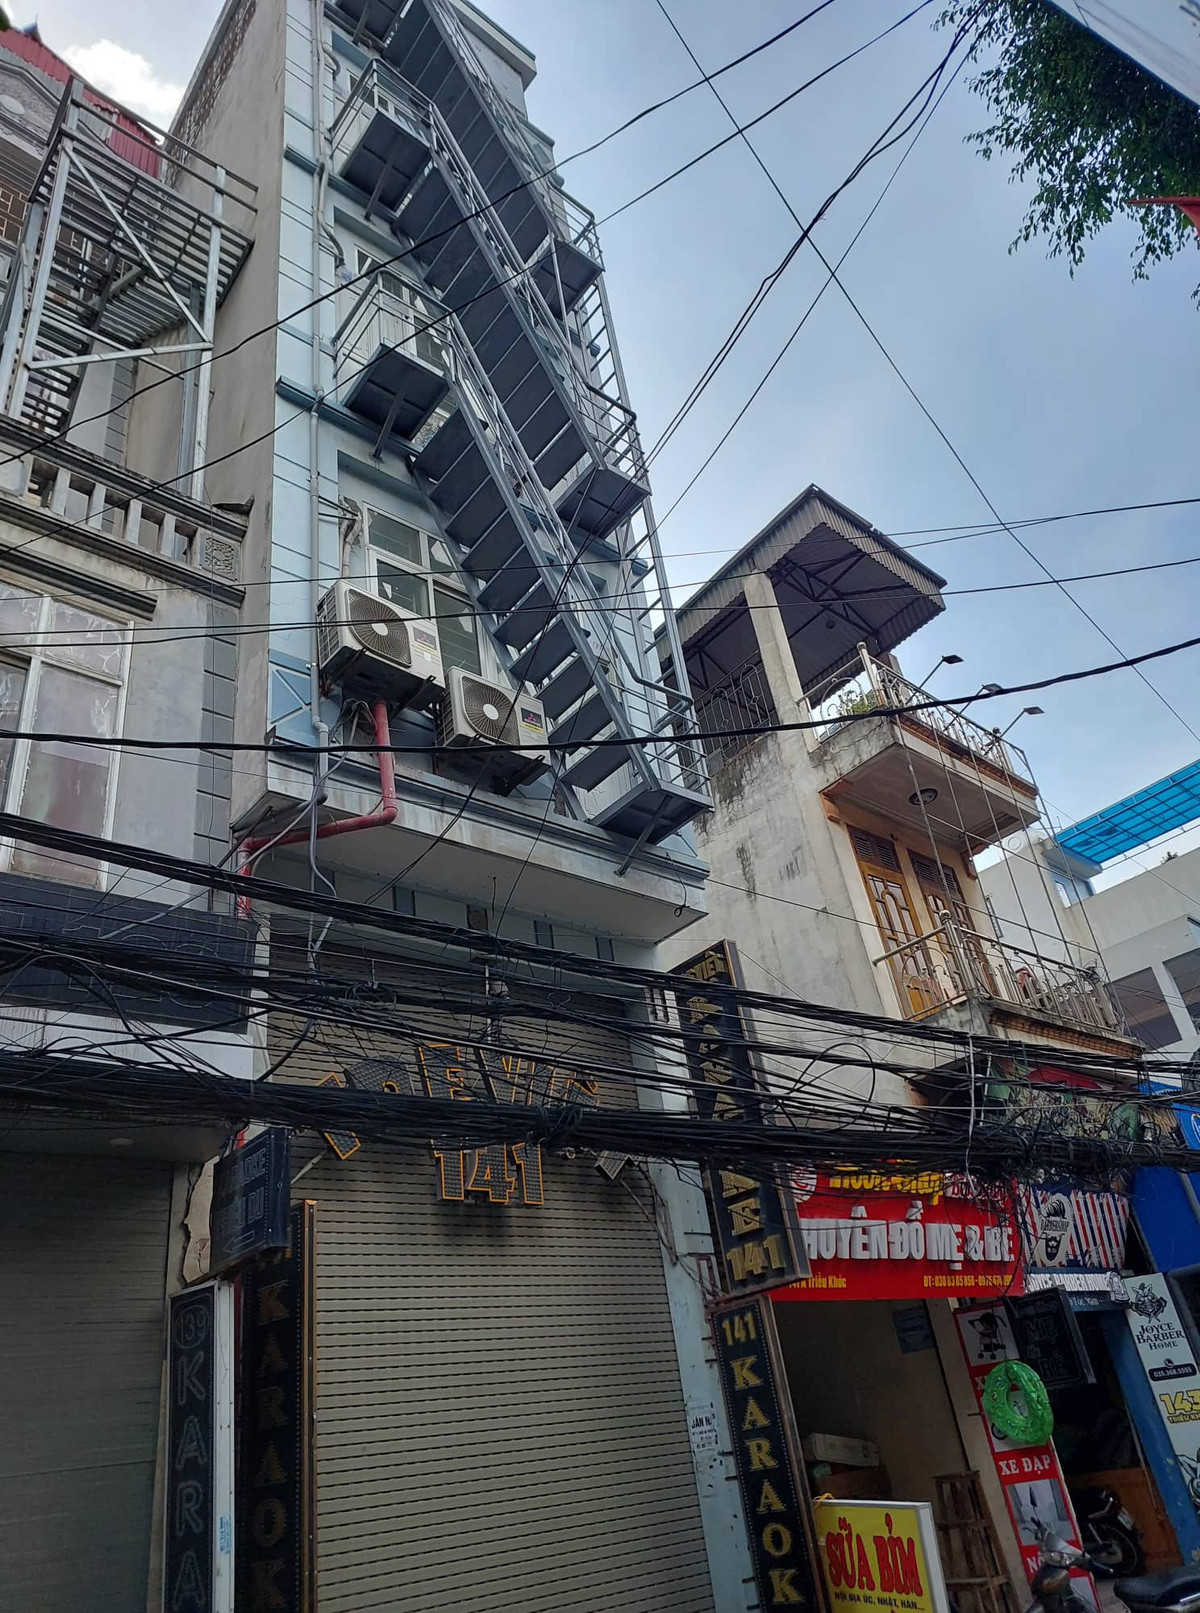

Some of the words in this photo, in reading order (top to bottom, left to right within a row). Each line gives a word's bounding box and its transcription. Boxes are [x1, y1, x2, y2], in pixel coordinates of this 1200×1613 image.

[430, 1138, 544, 1205] 141
[800, 1205, 888, 1260] HUYÊN
[925, 1222, 964, 1271] MẸ
[965, 1225, 984, 1262] &
[726, 1234, 788, 1281] 141
[808, 1271, 827, 1289] Triều
[828, 1274, 847, 1289] Khúc
[721, 1312, 757, 1346] 141
[1136, 1330, 1185, 1344] BARBER
[1139, 1322, 1175, 1336] JOYCE
[1148, 1340, 1178, 1351] HOME
[999, 1458, 1022, 1477] XE
[1023, 1455, 1051, 1476] ĐẠP
[826, 1516, 875, 1592] SỮA
[873, 1512, 923, 1597] BỈM
